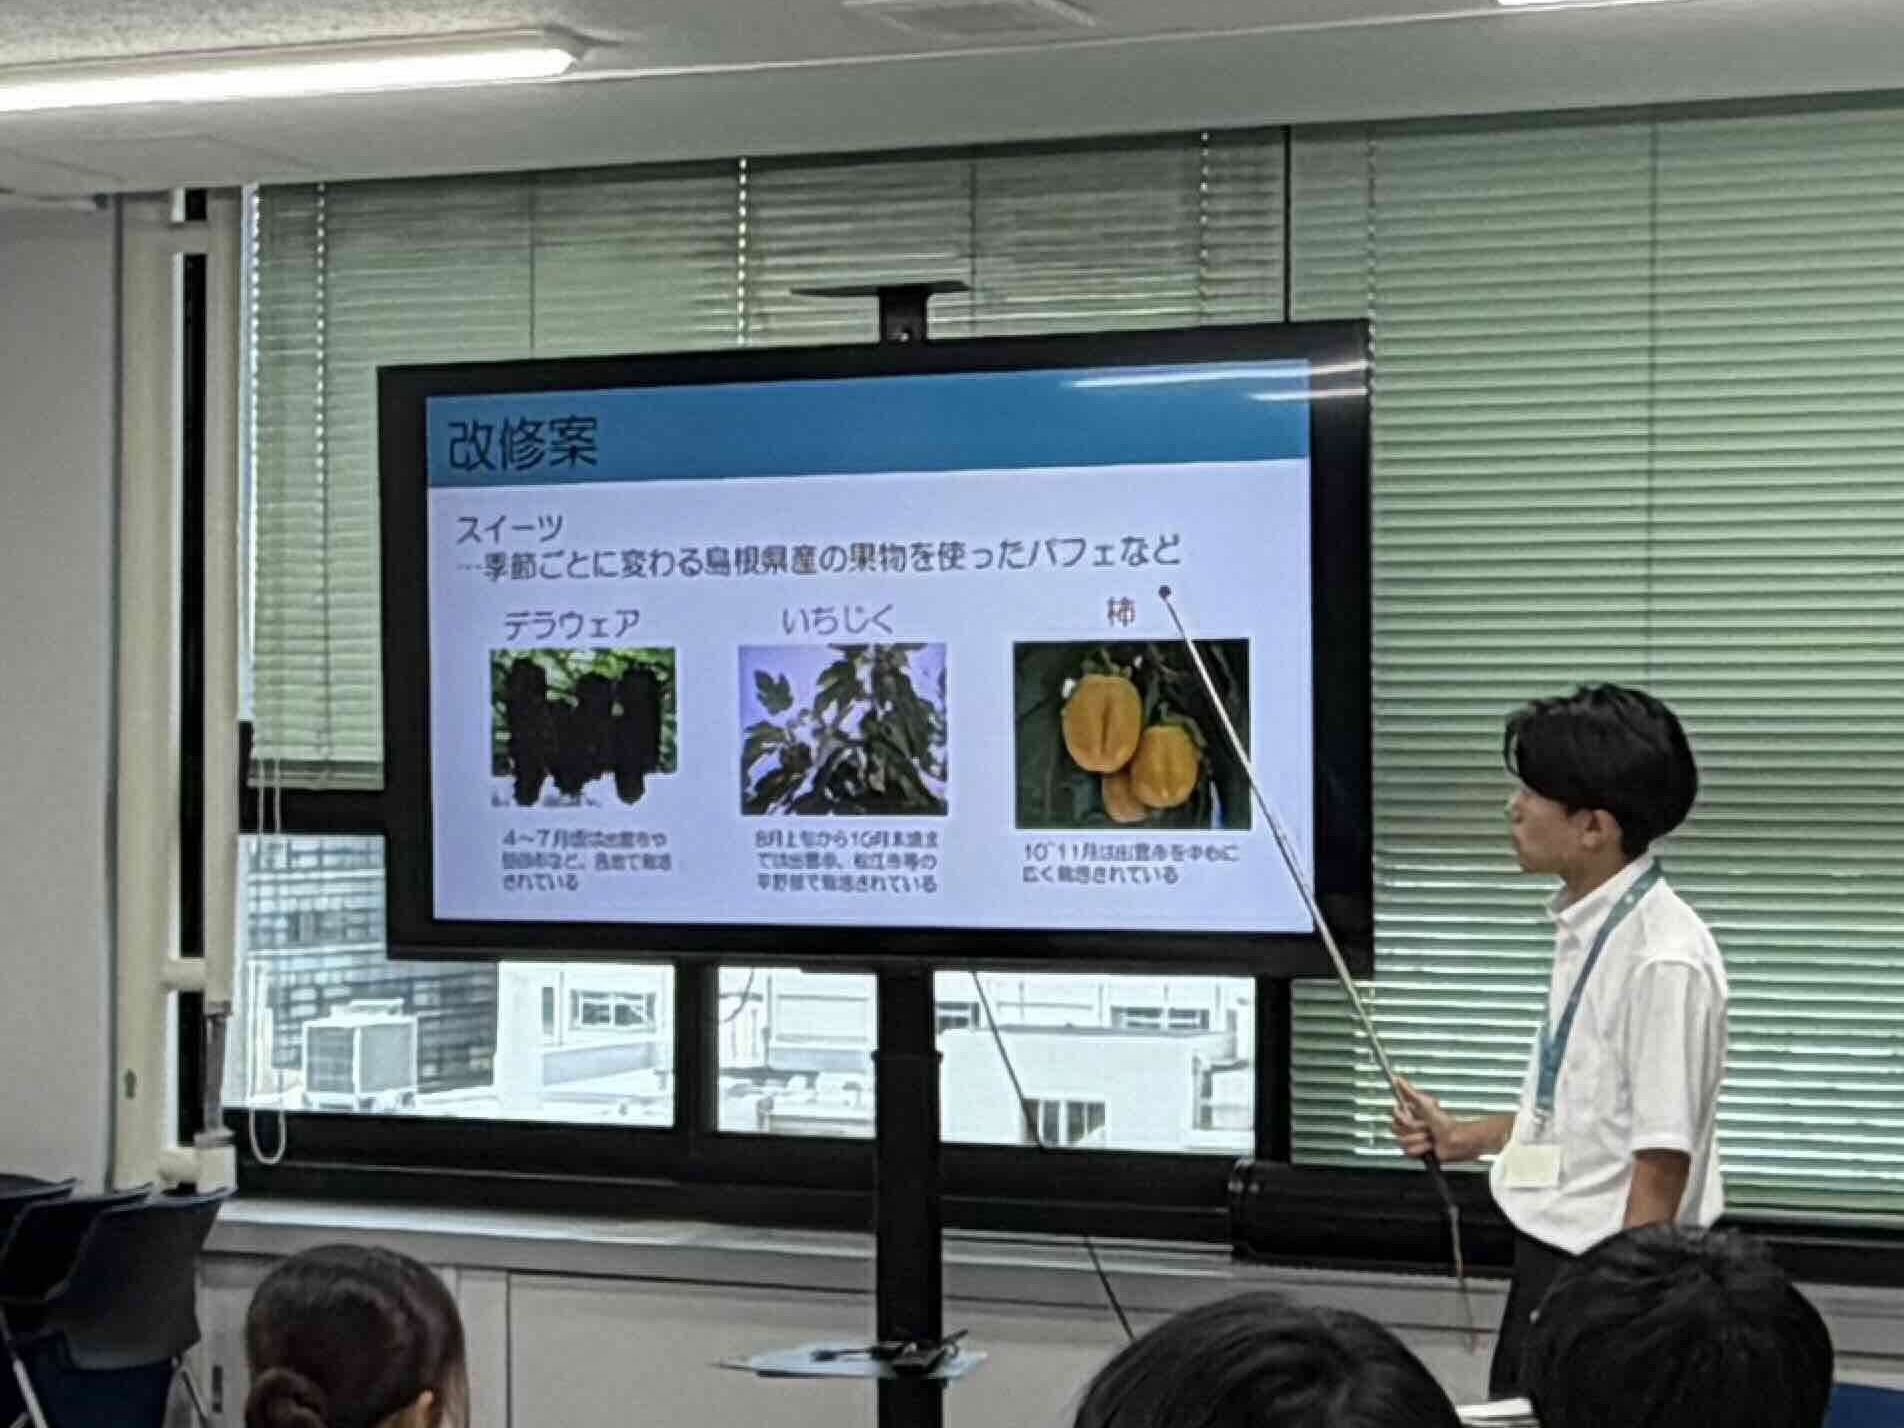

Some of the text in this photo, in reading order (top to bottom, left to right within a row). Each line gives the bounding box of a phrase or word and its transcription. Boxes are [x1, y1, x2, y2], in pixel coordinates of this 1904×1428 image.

[448, 414, 599, 471] 改修案
[456, 515, 564, 545] スイーツ
[504, 610, 641, 641] デラウェア
[782, 603, 895, 636] いちじく
[1106, 595, 1137, 627] 柿
